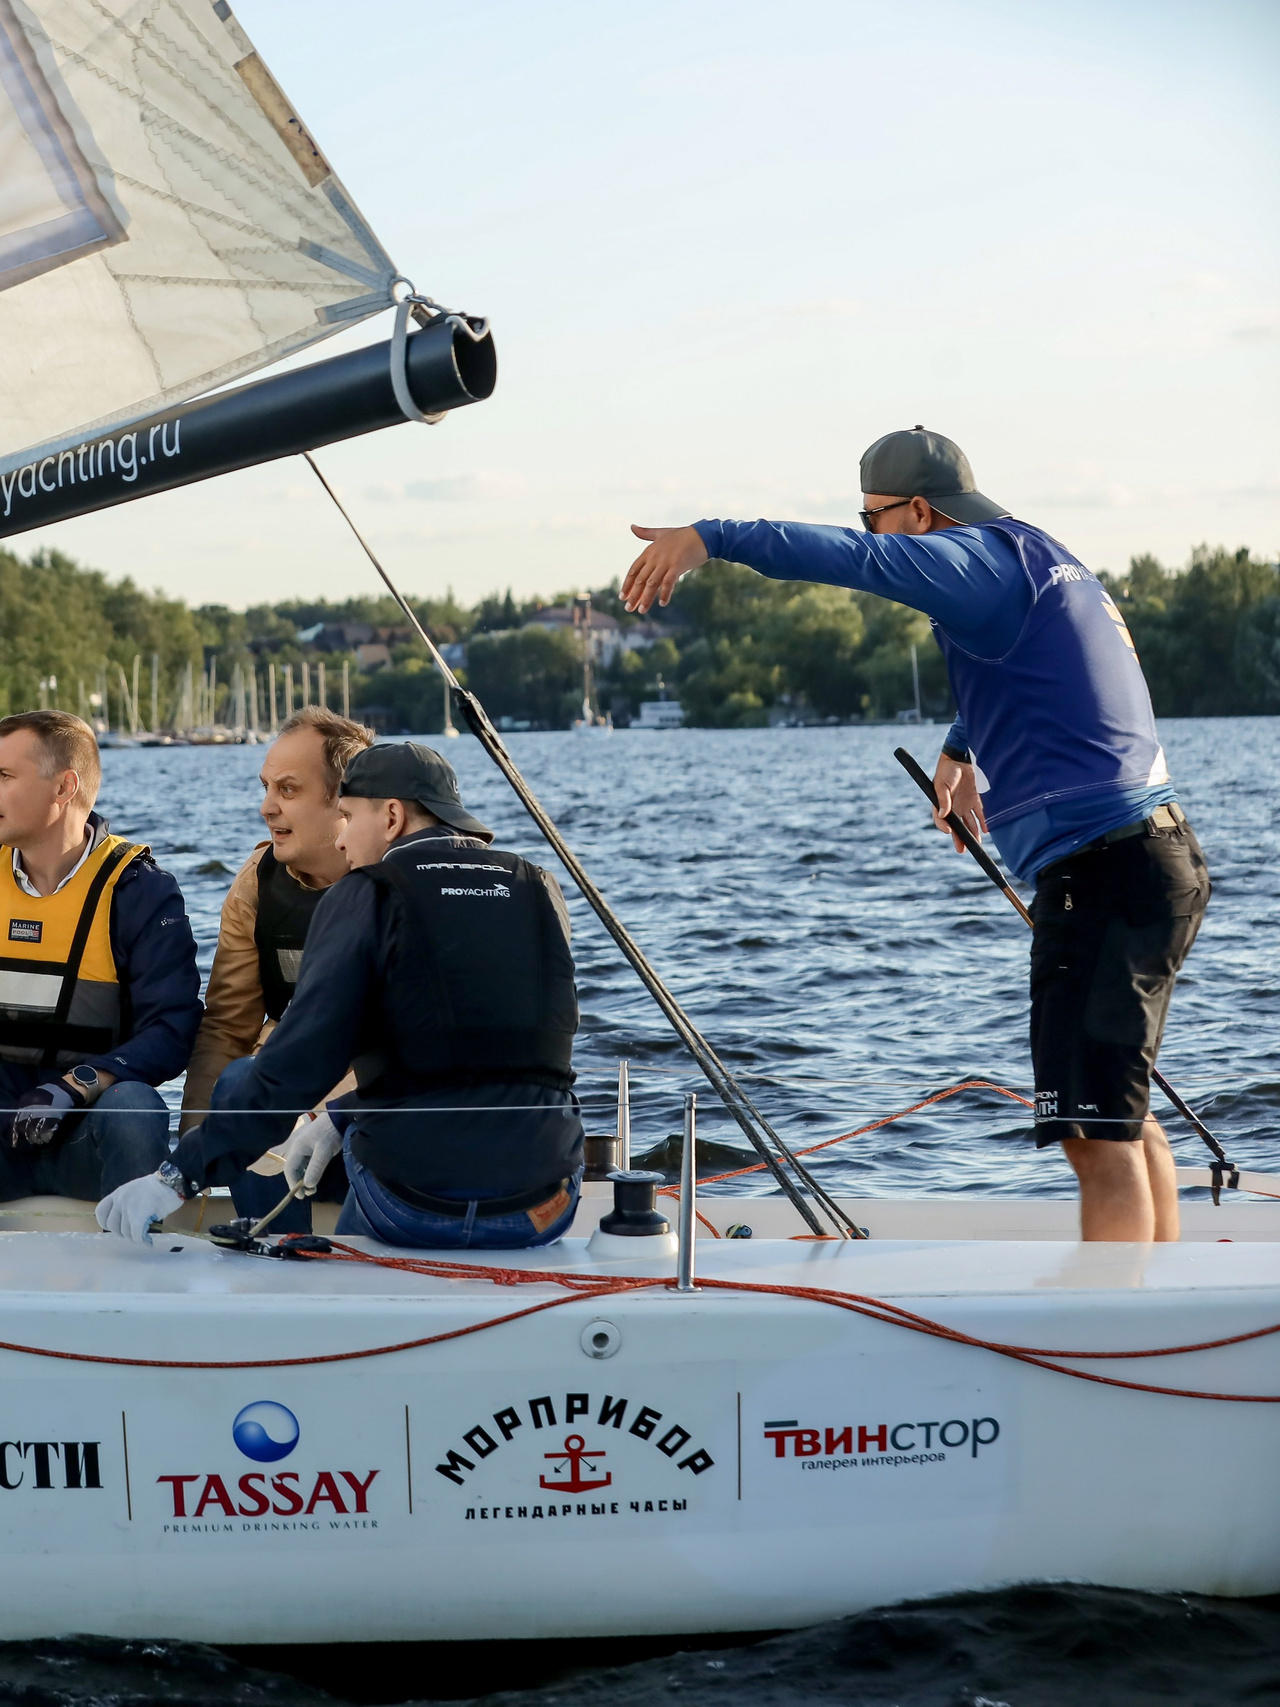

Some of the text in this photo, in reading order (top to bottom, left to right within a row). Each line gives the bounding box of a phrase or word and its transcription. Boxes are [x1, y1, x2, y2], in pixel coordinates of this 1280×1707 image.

[441, 887, 510, 897] PROYACHTING
[12, 922, 40, 930] MARINE
[435, 1392, 715, 1486] МОРПРИБОР
[801, 1451, 946, 1471] галерея интерьеров
[156, 1469, 381, 1517] TASSAY
[465, 1498, 688, 1520] ЛЕГЕНДАРНЫЕ ЧАСЫ
[163, 1519, 379, 1533] PREMIUM DRINKING WATER
